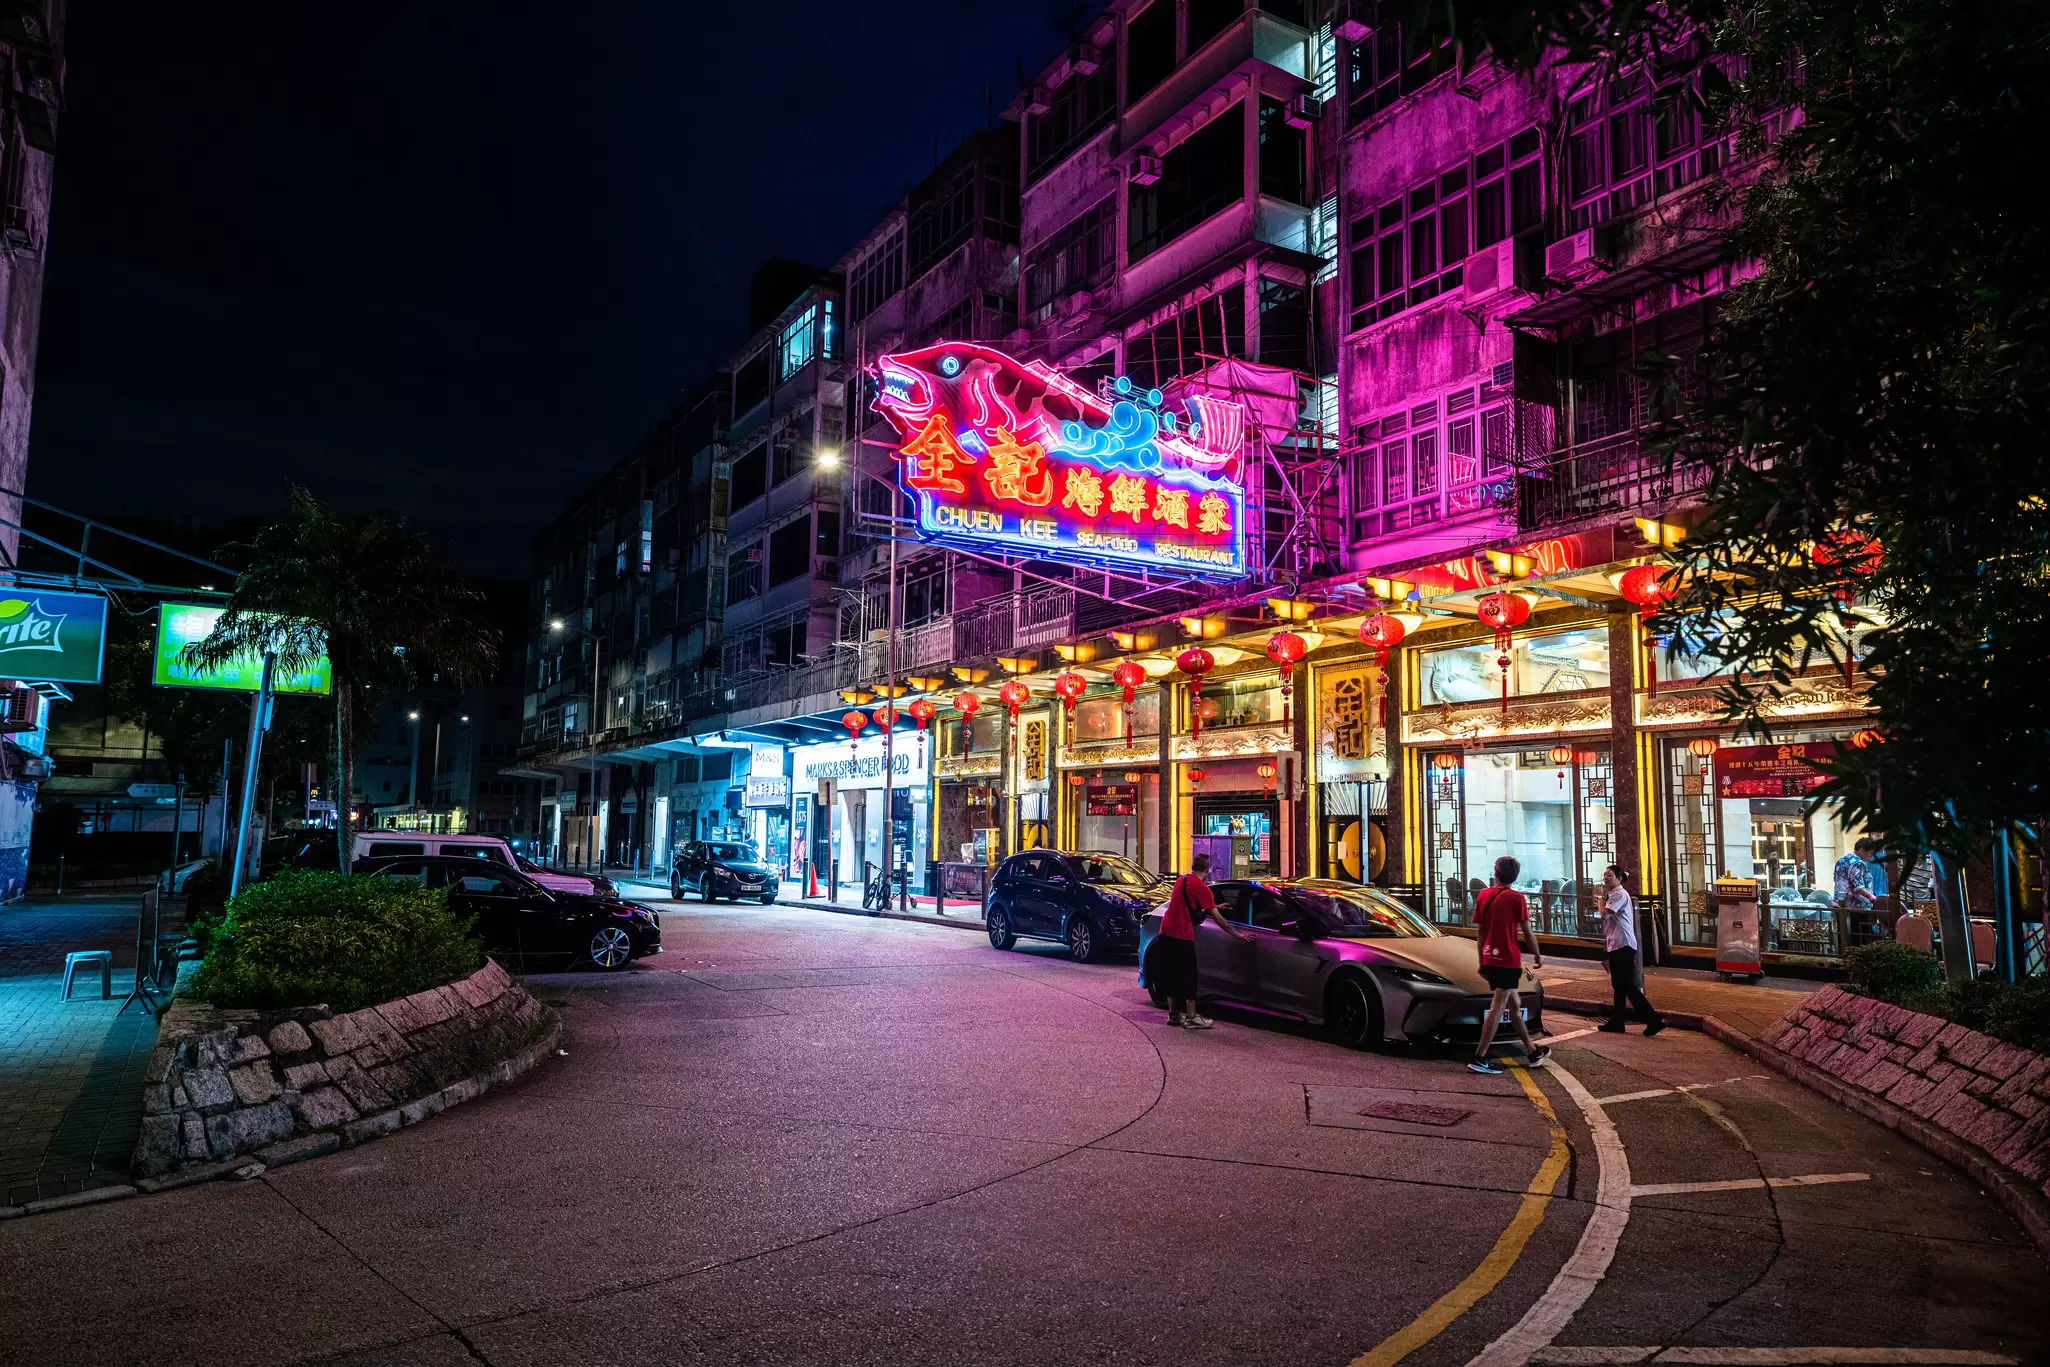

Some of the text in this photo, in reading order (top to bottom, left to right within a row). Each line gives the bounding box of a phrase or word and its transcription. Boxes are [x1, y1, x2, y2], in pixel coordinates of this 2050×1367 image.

[935, 505, 1236, 566] CHUEN KEE SEAFOOD RESTAURANT
[1334, 677, 1364, 759] 全記
[756, 752, 780, 763] M&S
